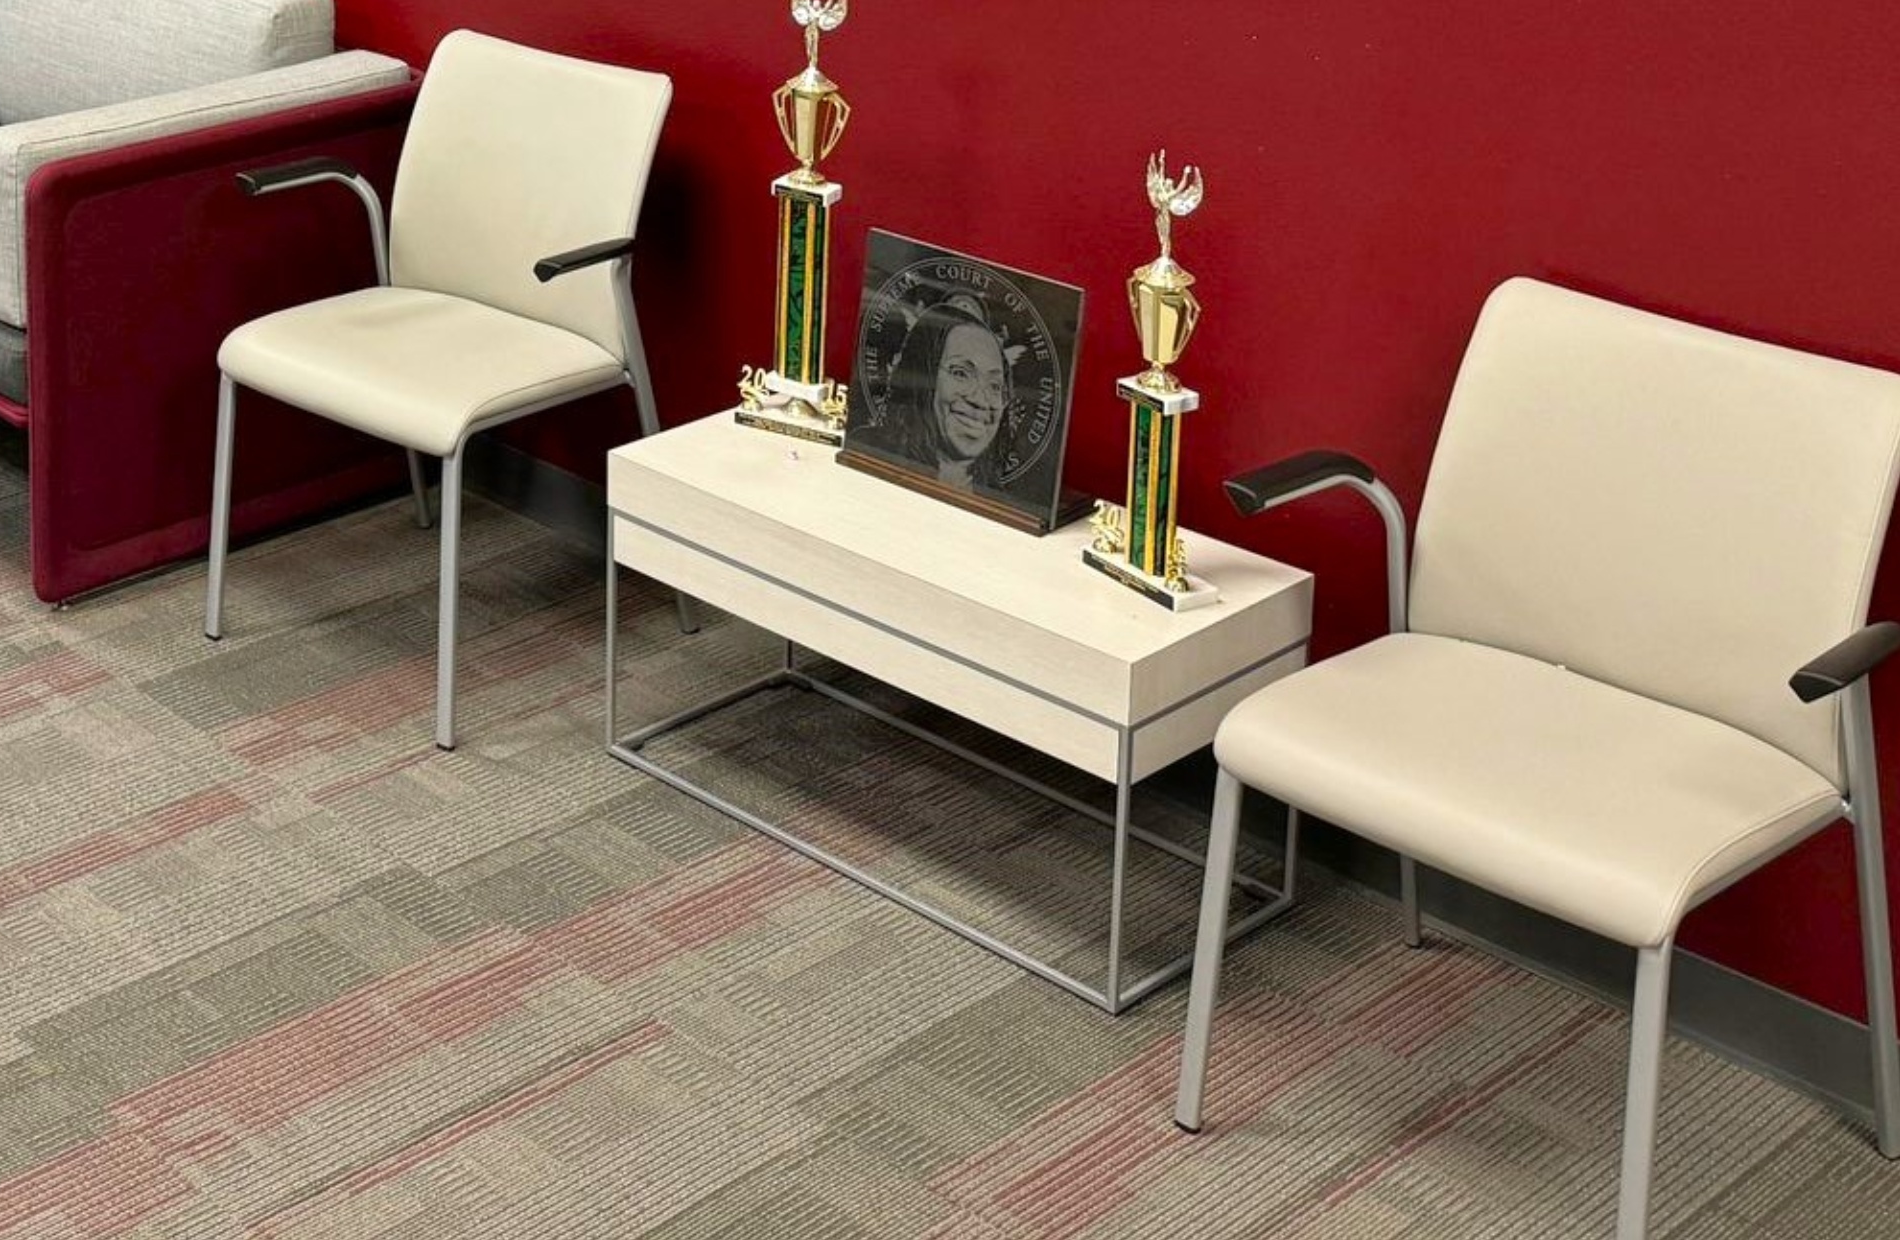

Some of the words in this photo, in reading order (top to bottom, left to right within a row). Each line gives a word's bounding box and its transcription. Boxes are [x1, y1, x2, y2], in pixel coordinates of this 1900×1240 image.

[936, 265, 992, 289] COURT
[1004, 292, 1025, 314] OF
[1026, 324, 1050, 361] THE
[738, 363, 768, 391] 20
[866, 346, 878, 383] THE
[1027, 377, 1054, 445] UNITED
